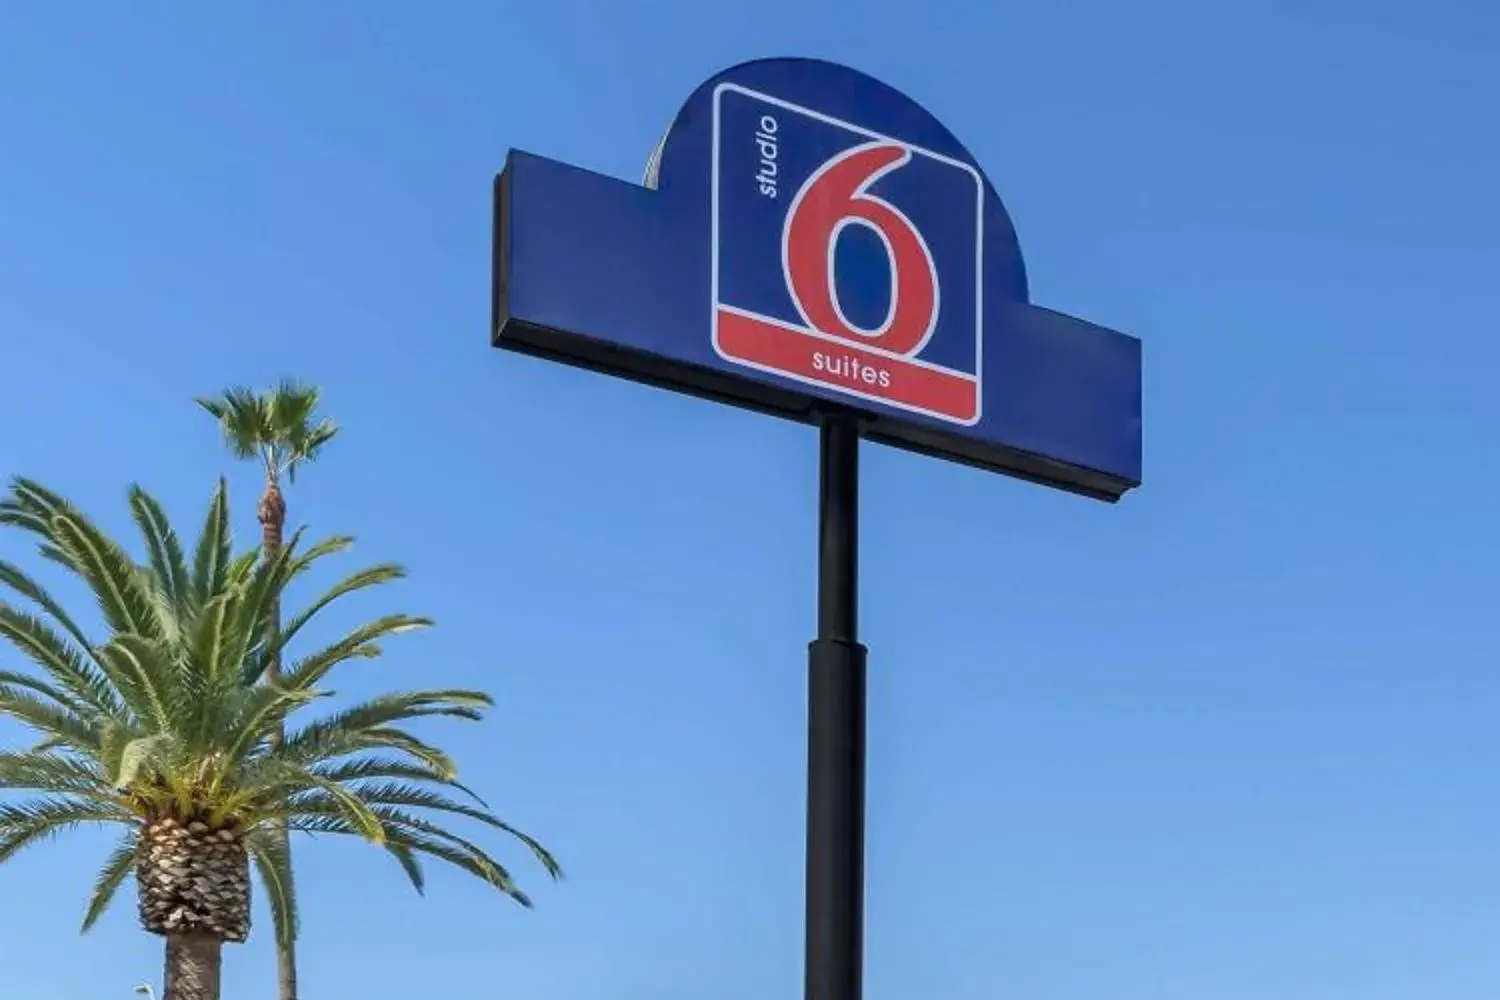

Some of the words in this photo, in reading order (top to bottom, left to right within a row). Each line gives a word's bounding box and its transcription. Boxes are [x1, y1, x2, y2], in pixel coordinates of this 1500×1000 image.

[755, 115, 777, 198] studio
[781, 139, 940, 359] 6
[811, 351, 891, 388] suites
